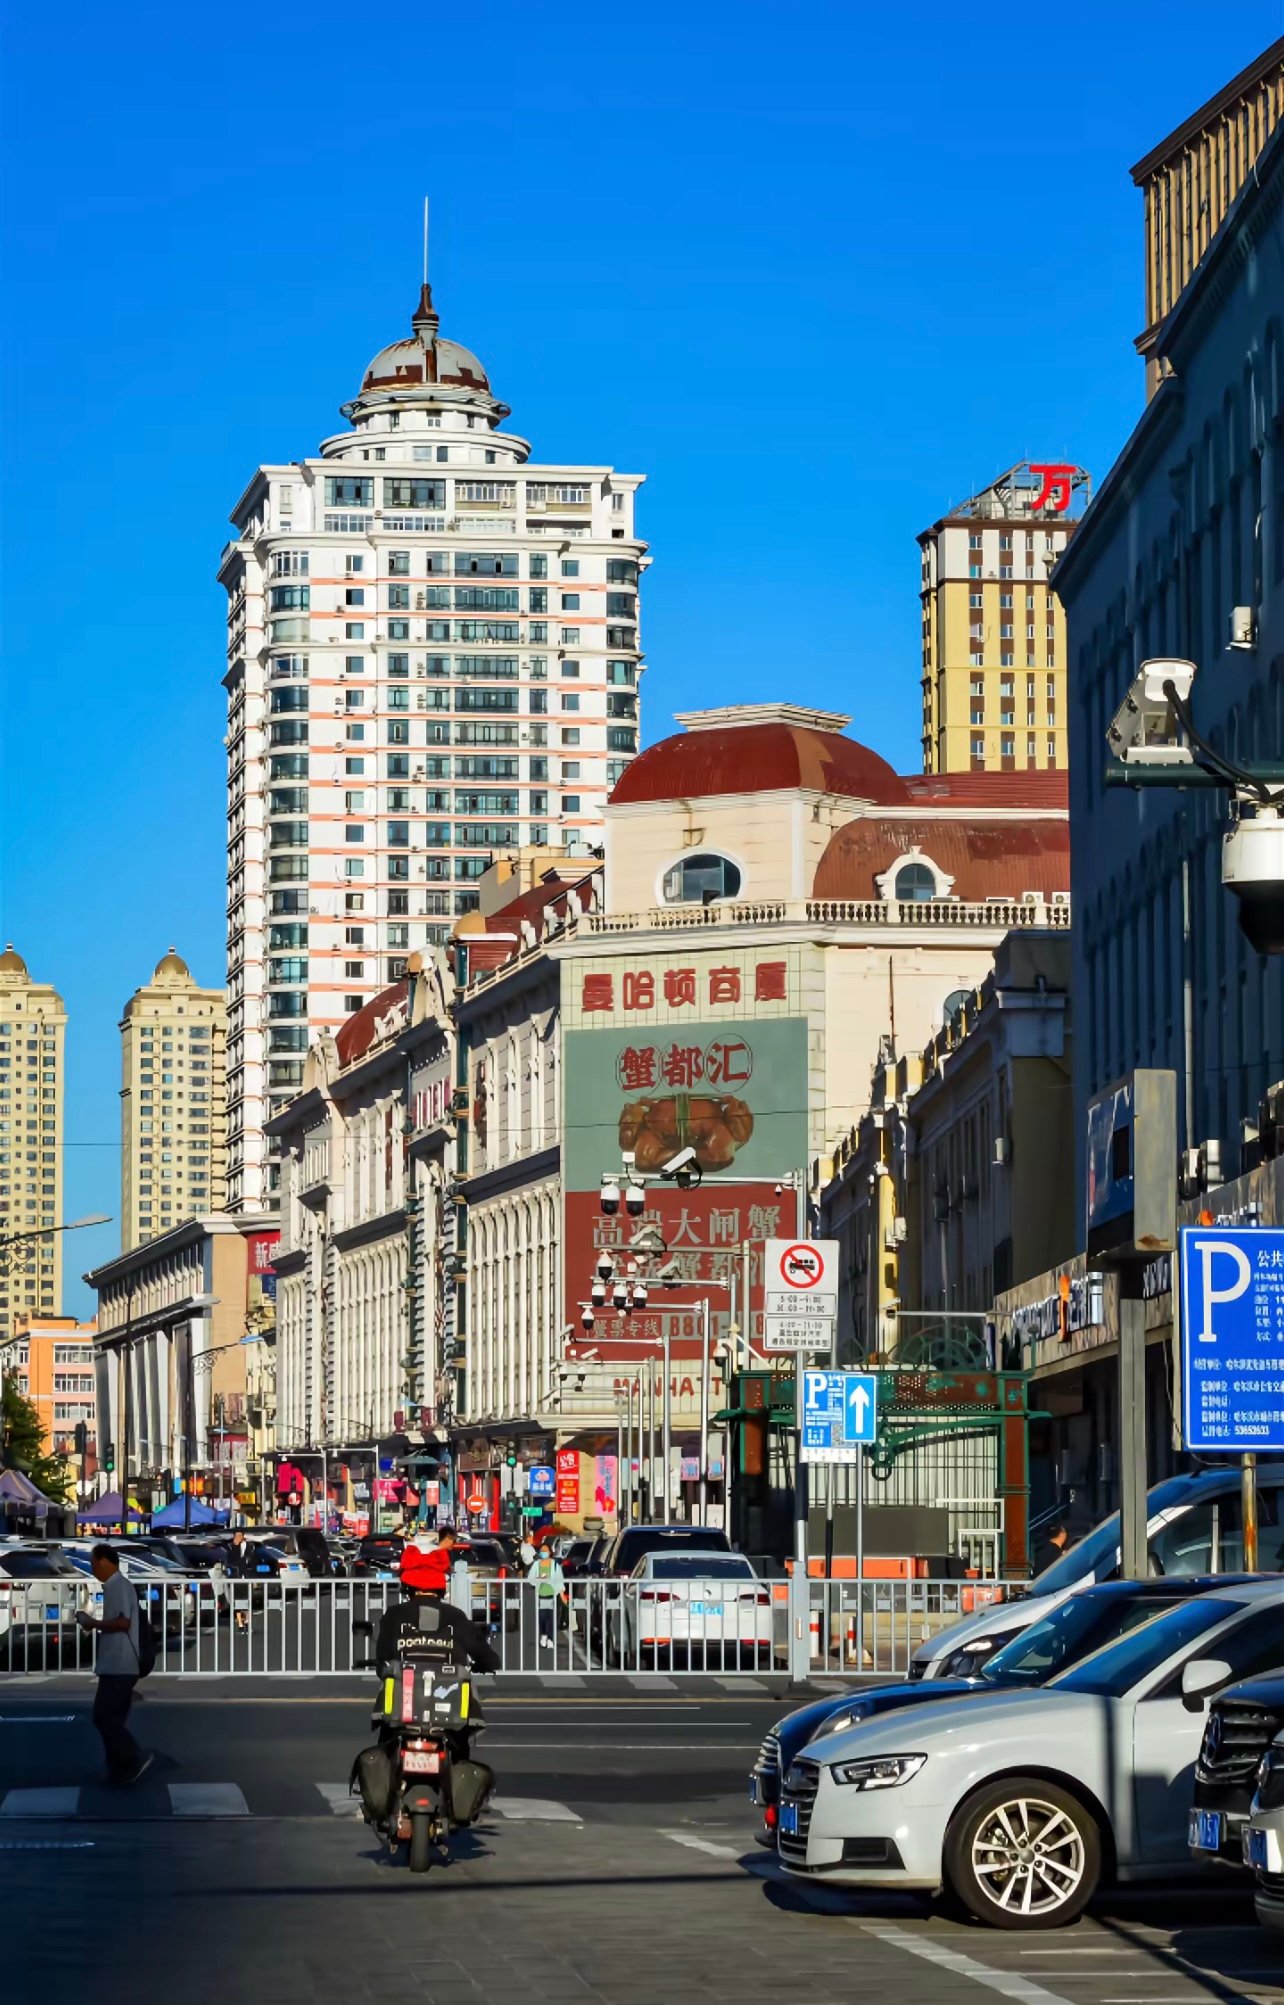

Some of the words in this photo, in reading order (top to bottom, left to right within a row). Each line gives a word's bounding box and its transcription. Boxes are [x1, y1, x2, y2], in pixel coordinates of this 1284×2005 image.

[1030, 465, 1077, 511] 万
[581, 961, 788, 1013] 曼哈顿商厦
[620, 1040, 751, 1090] 蟹都汇
[592, 1204, 781, 1247] 高端大闸蟹
[1194, 1241, 1252, 1343] P
[805, 1373, 828, 1409] P
